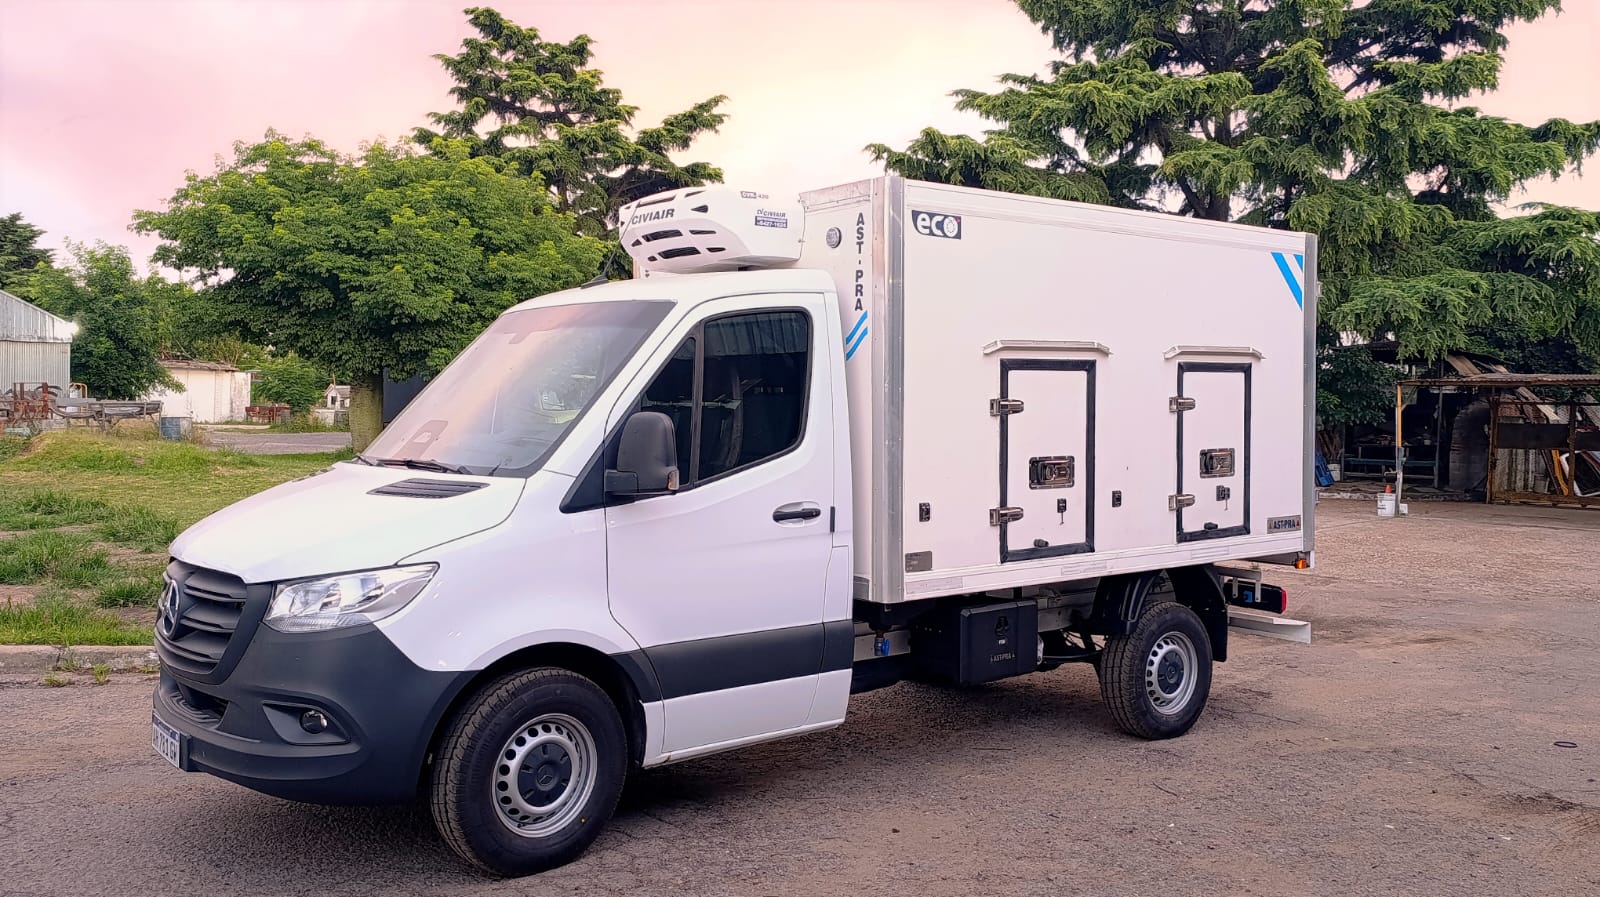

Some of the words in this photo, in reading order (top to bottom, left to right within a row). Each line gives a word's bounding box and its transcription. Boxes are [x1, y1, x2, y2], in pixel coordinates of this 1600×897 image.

[631, 208, 675, 225] CIVIAIR
[916, 213, 958, 237] eco
[1273, 519, 1296, 529] AST-PRA
